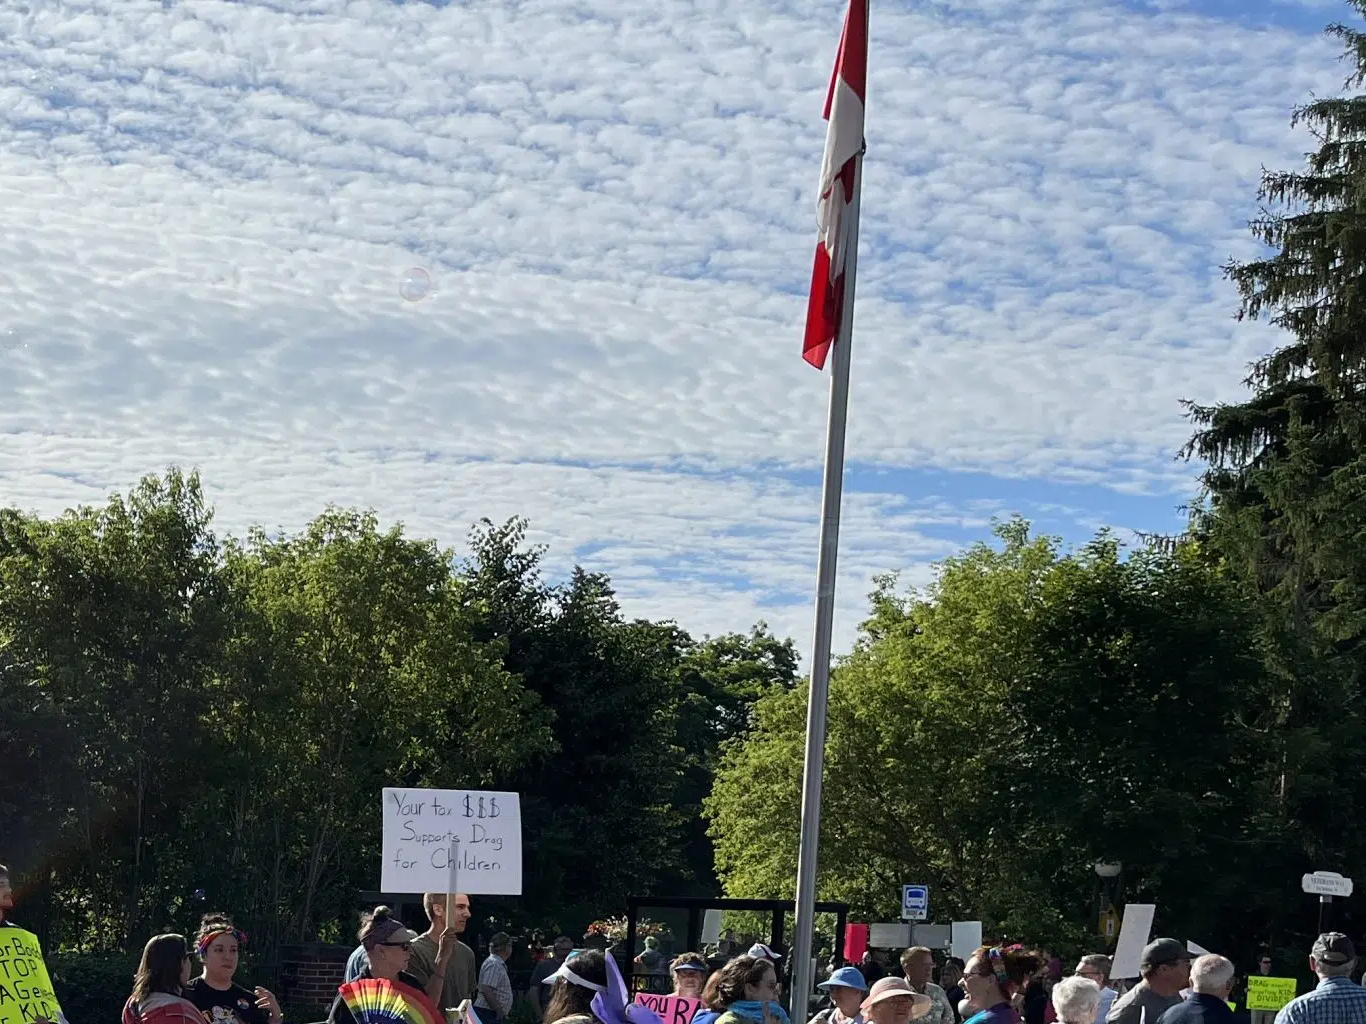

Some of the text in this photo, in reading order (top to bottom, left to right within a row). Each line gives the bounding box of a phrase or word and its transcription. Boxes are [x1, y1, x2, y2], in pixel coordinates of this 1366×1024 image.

[394, 793, 426, 816] Your
[431, 797, 452, 816] tax
[401, 820, 503, 851] Supports Drag
[393, 848, 501, 871] for Children
